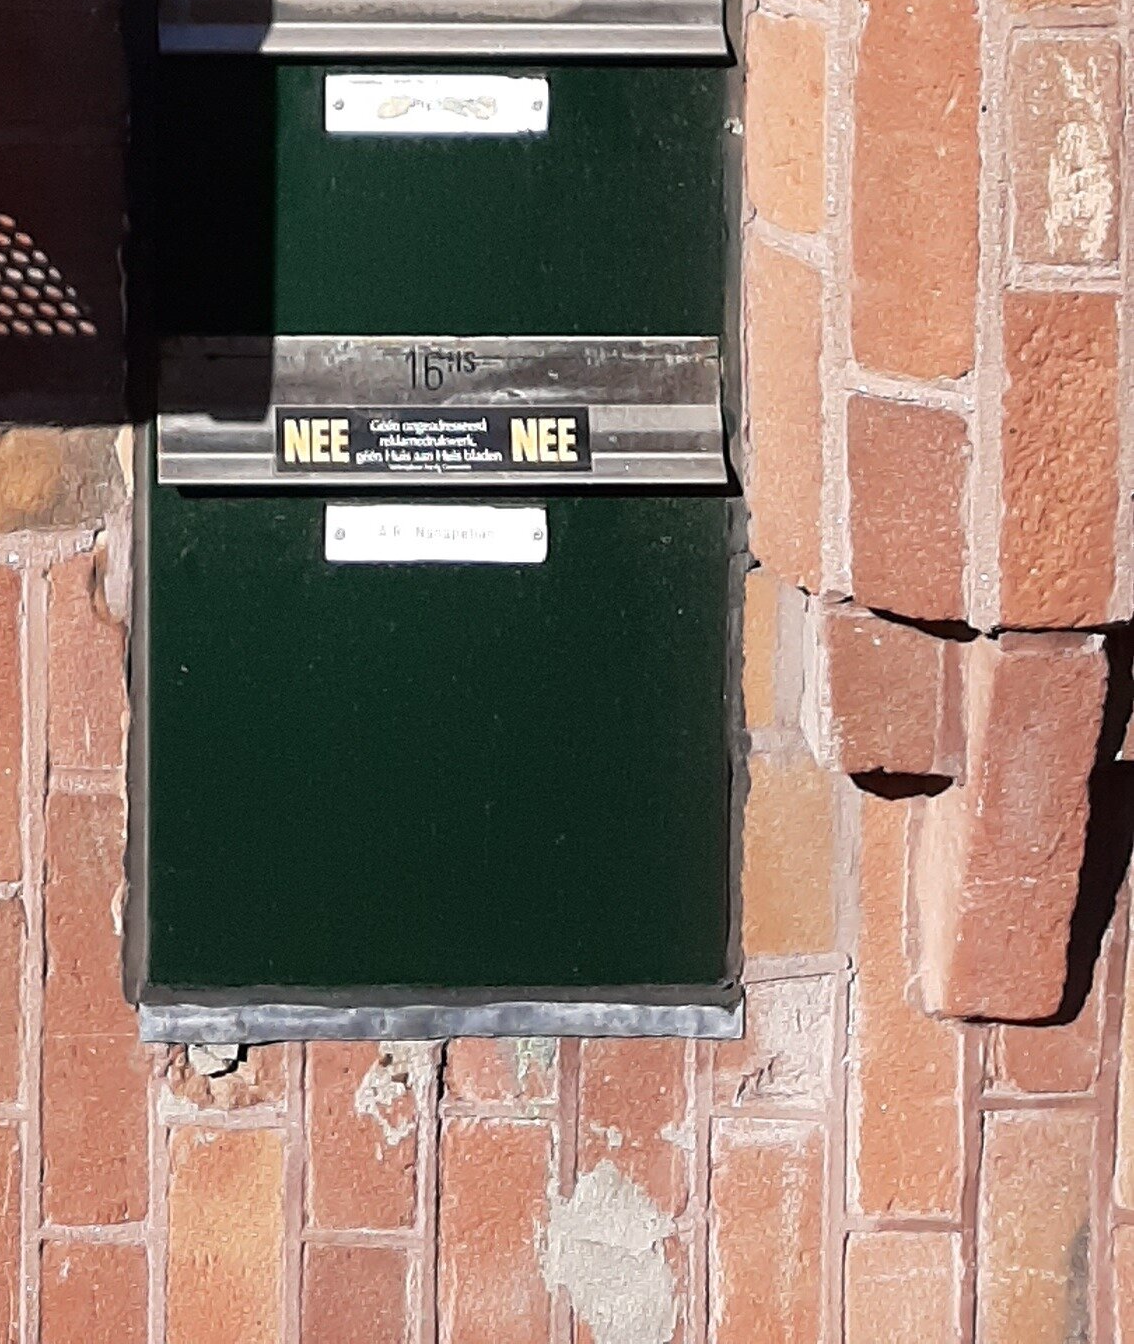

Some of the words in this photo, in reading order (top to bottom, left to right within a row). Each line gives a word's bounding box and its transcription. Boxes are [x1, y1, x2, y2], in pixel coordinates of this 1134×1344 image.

[282, 417, 351, 464] NEE
[401, 417, 488, 435] ongeadresseerd
[509, 416, 578, 463] NEE
[385, 448, 412, 462] Huis
[413, 450, 435, 462] aan
[435, 448, 463, 462] Huis
[463, 447, 503, 462] bladen
